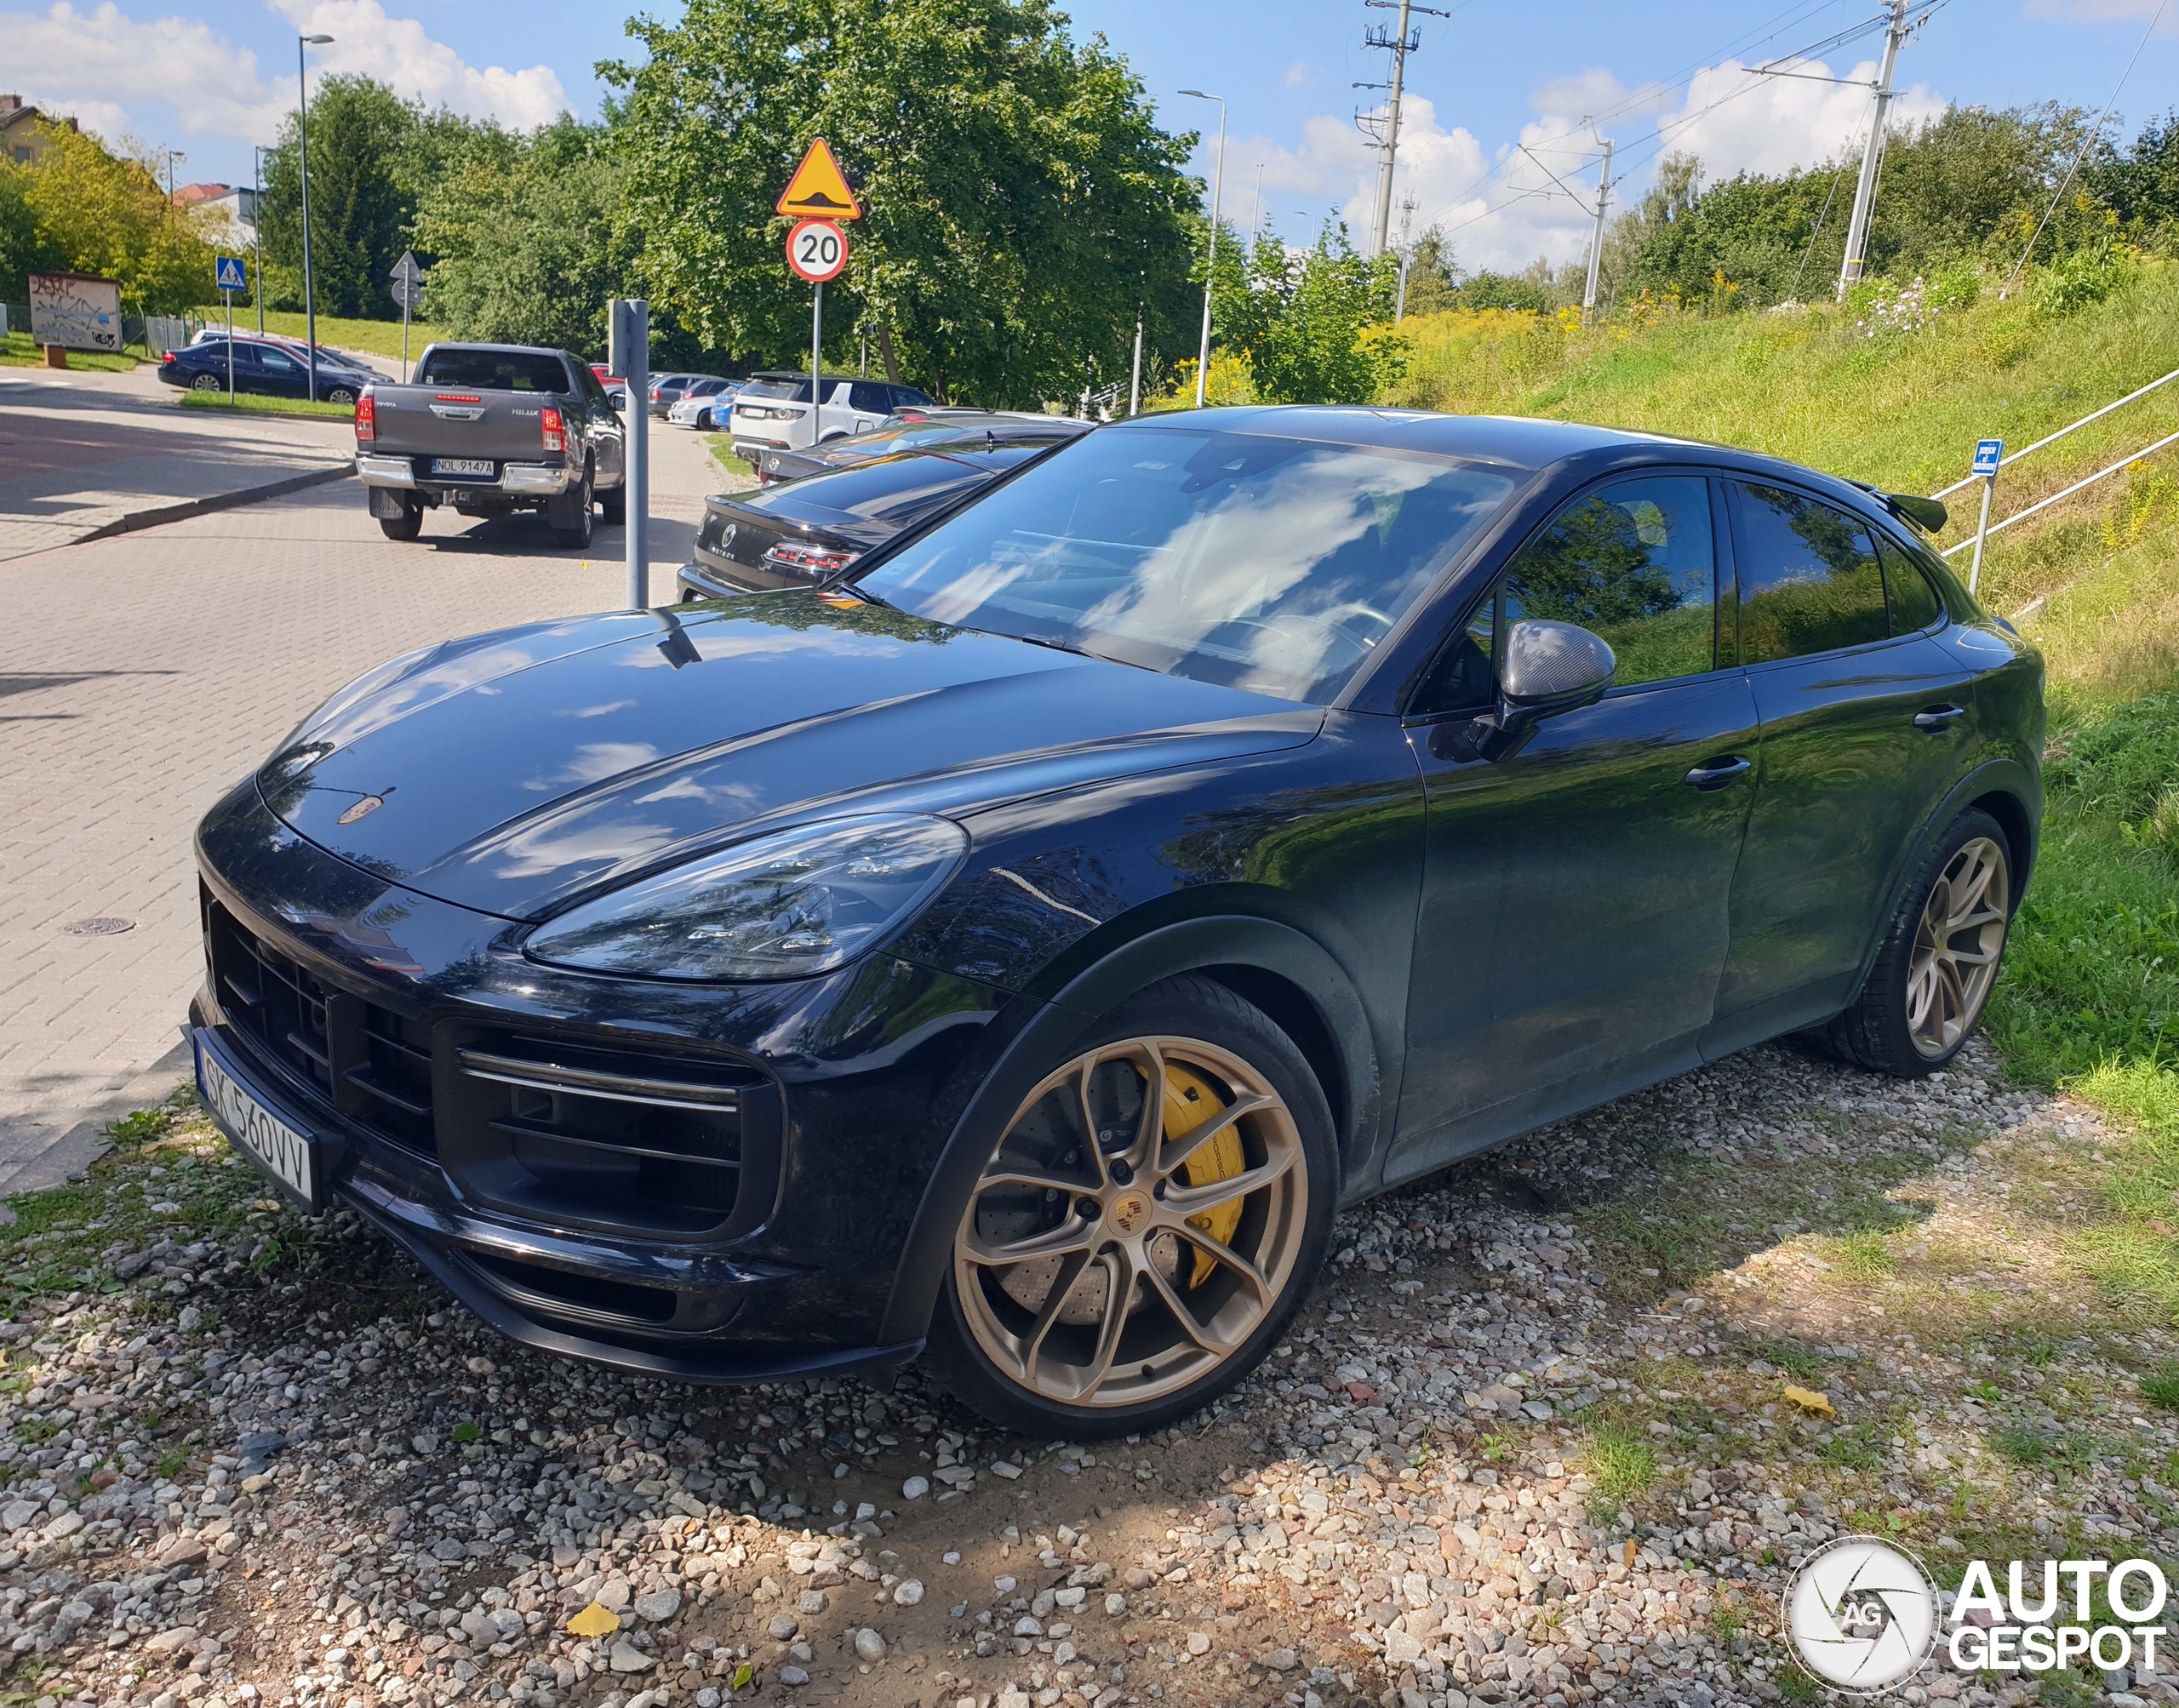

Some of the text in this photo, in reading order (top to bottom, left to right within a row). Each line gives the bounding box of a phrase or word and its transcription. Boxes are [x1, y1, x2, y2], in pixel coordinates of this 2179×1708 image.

[800, 234, 838, 265] 20
[438, 460, 492, 472] NOL 9147A
[206, 1057, 302, 1190] SK 560VV
[1212, 1135, 1226, 1180] PORSC
